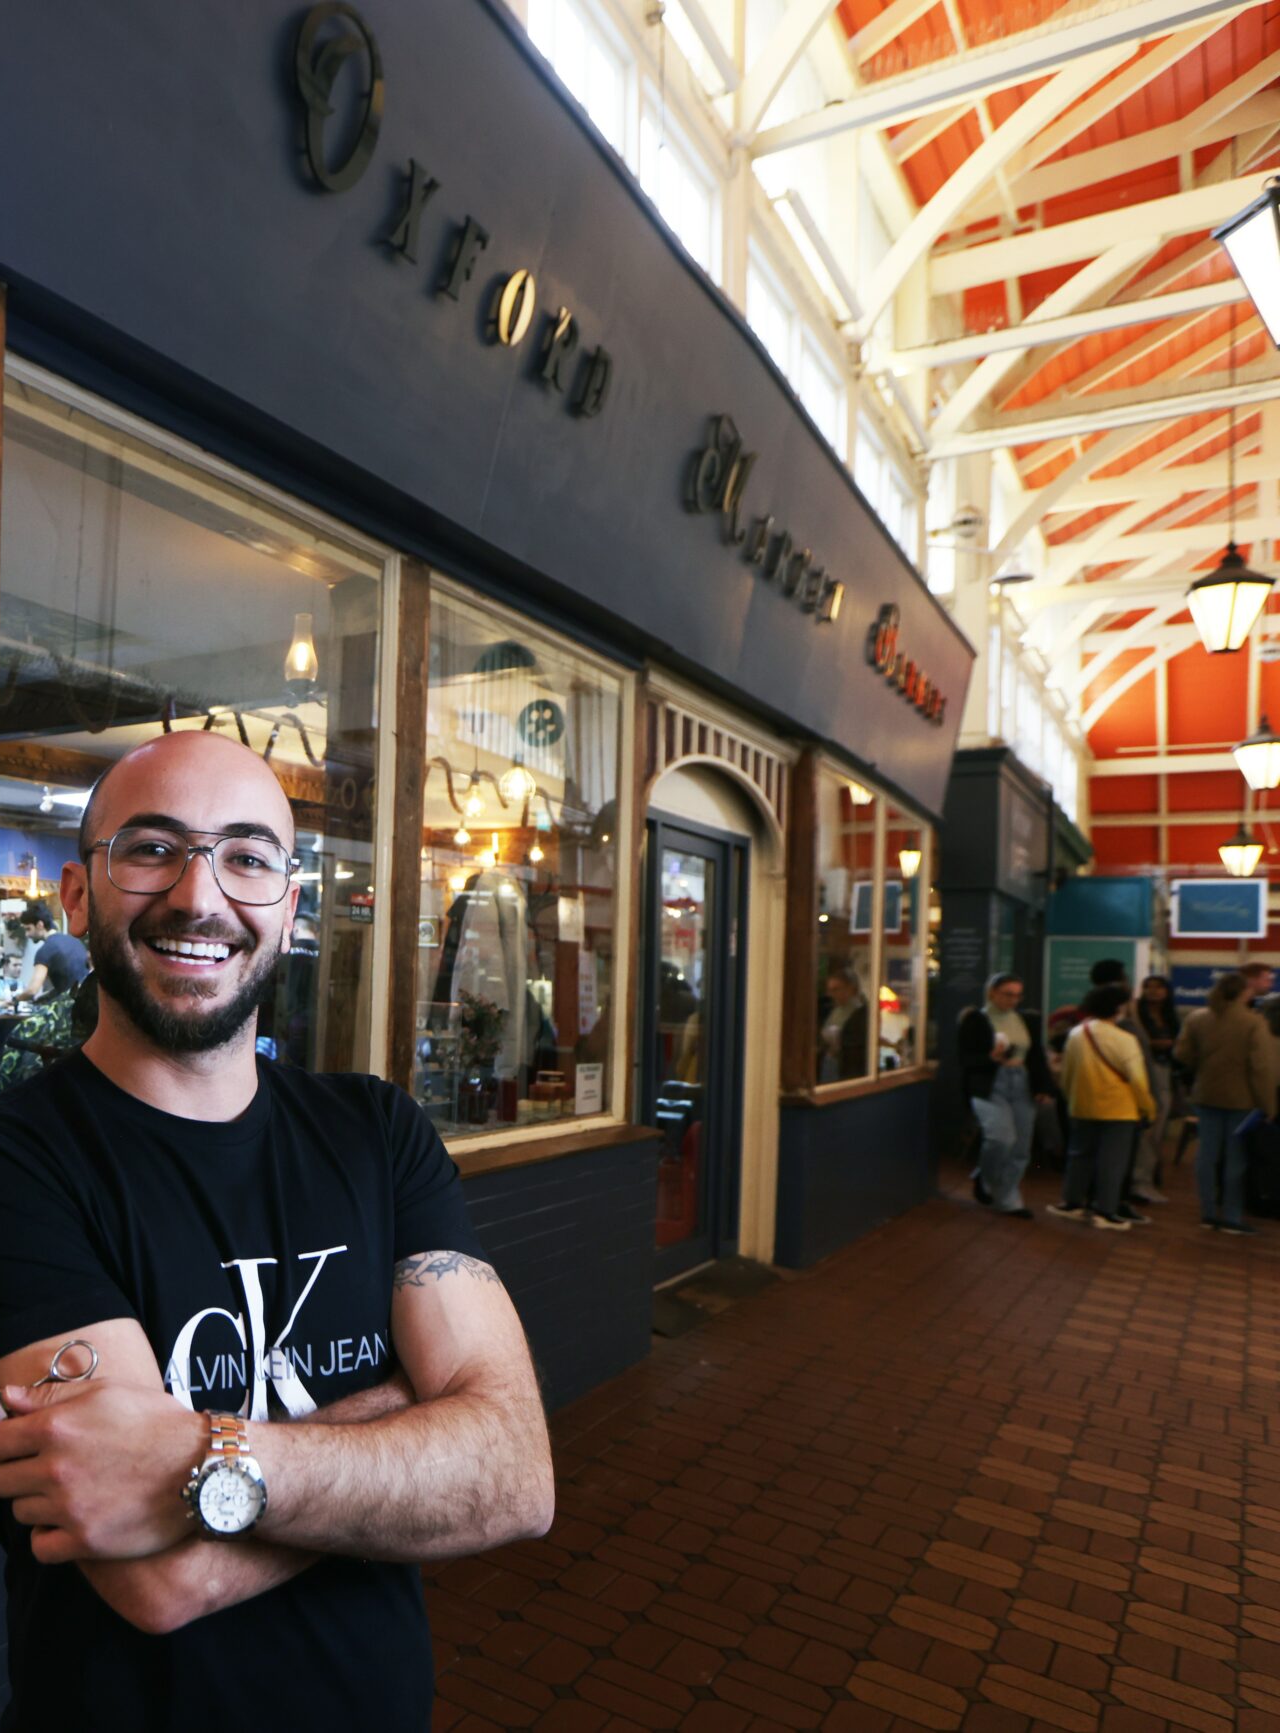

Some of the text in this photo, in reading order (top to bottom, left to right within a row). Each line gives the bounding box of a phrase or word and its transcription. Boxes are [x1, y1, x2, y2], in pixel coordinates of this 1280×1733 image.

[292, 1, 613, 418] OXFORD
[164, 1351, 247, 1392] ALVIN
[320, 1328, 389, 1376] JEAN
